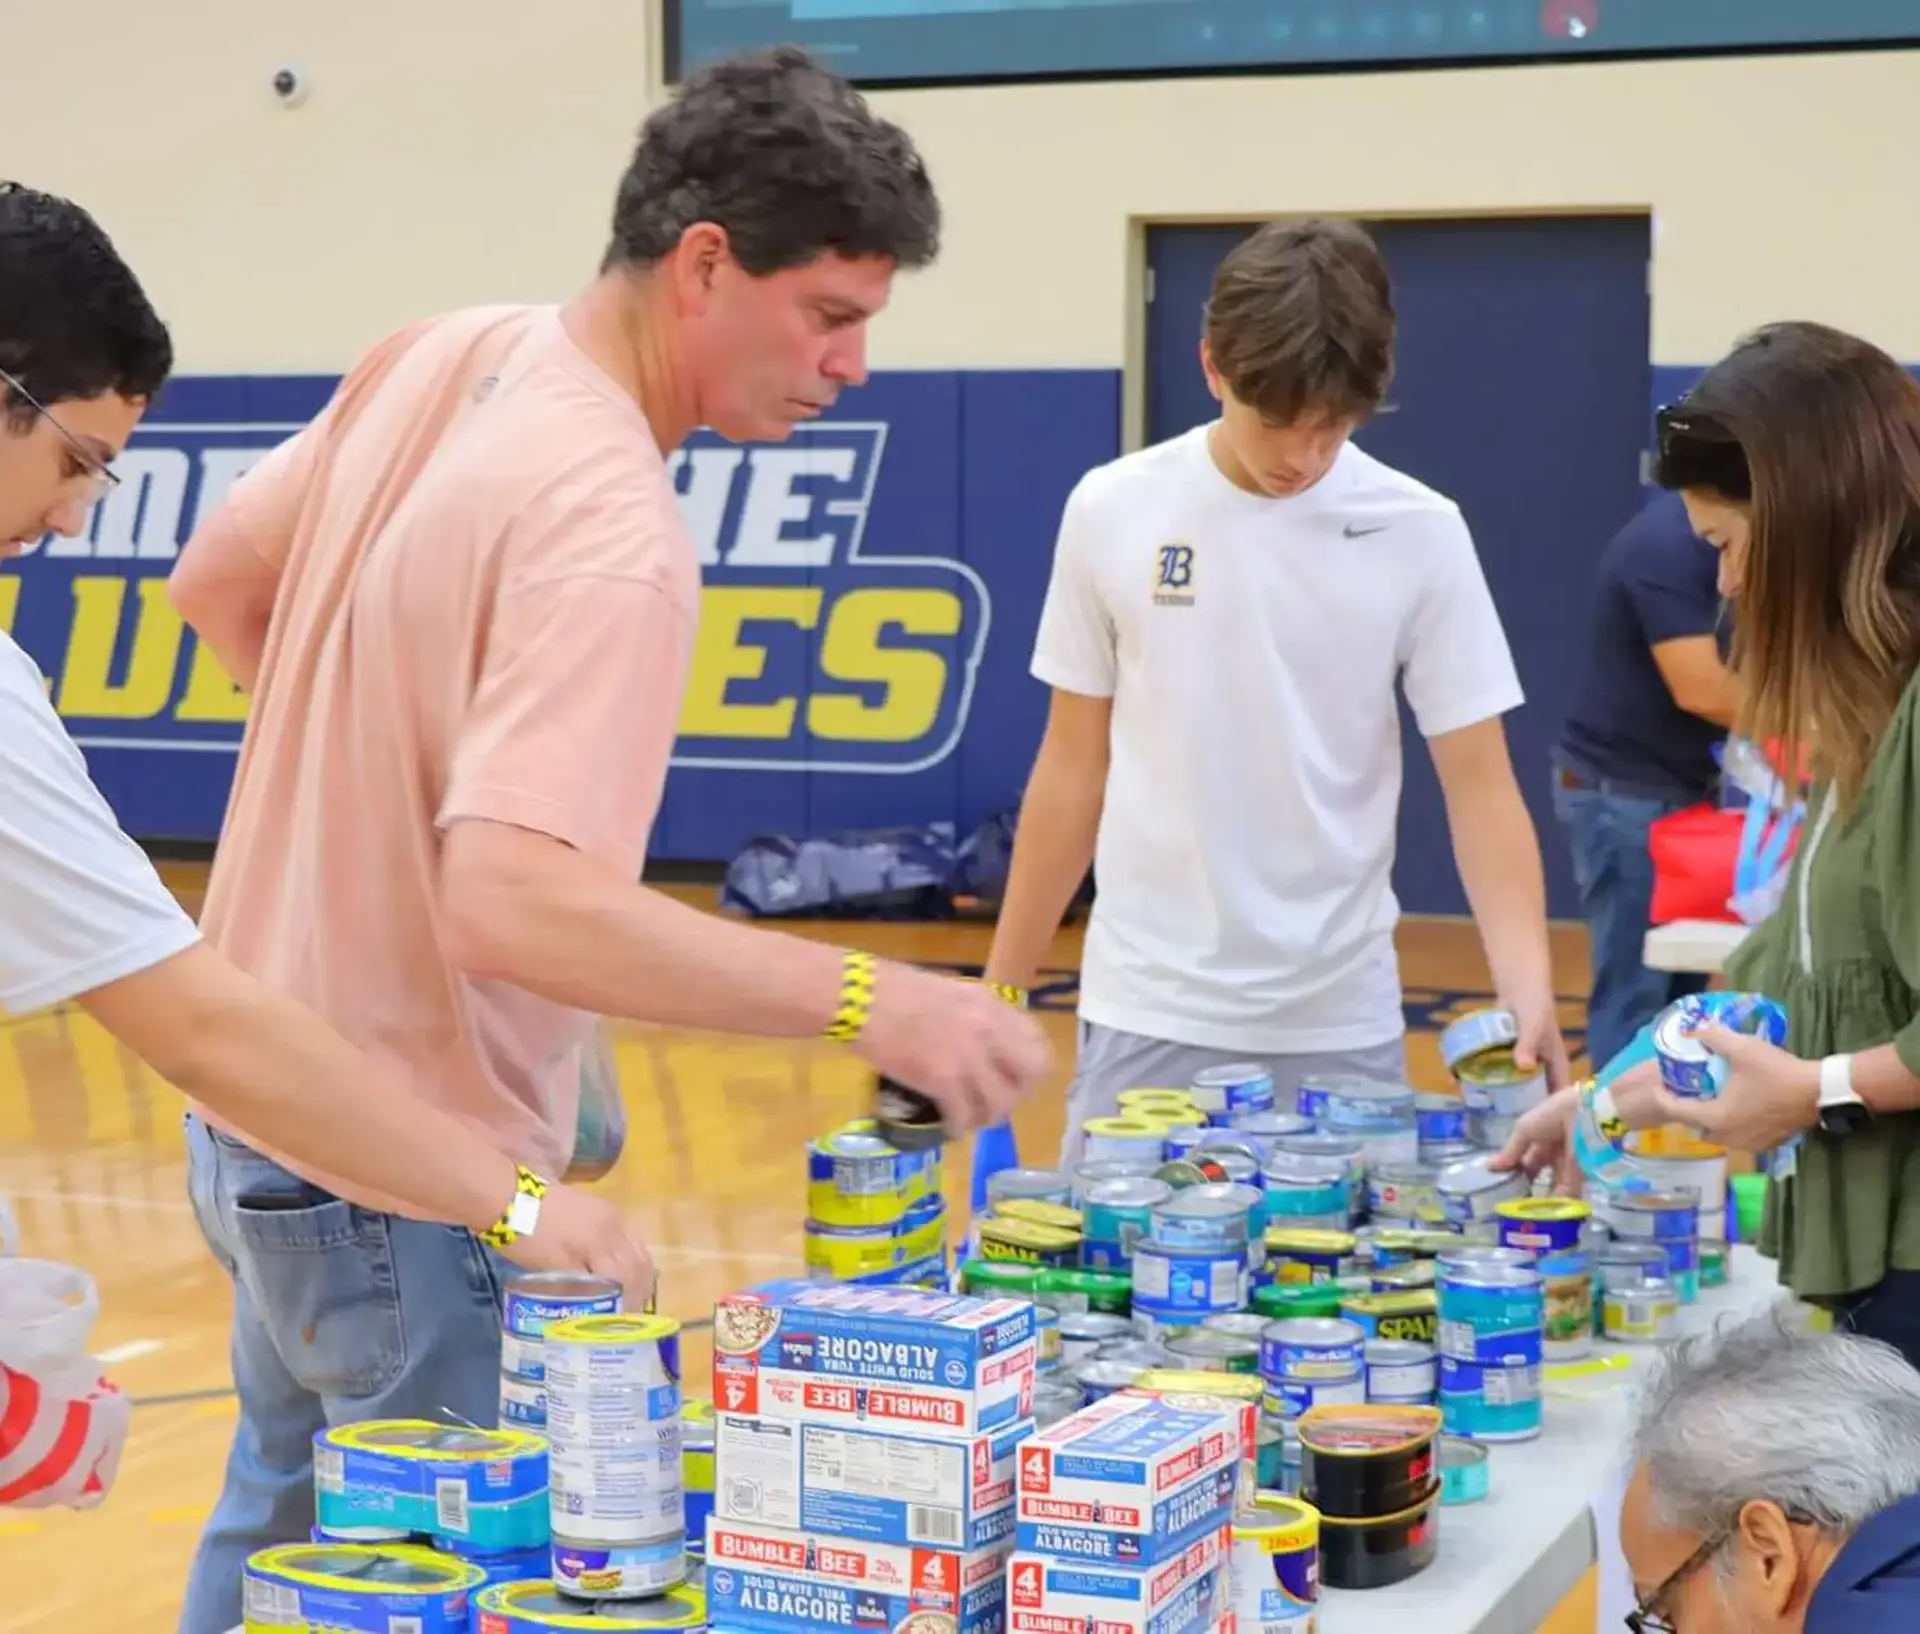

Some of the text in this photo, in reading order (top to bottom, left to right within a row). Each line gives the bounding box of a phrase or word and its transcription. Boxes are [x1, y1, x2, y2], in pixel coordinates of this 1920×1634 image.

[817, 1335, 938, 1366] ALBACORE
[726, 1388, 746, 1409] 4
[809, 1386, 957, 1420] BUMBLE BEE
[1025, 1453, 1046, 1476] 4
[1026, 1500, 1134, 1525] BUMBLE BEE
[722, 1535, 800, 1566] BUMBLE
[821, 1551, 858, 1575] BEE
[1035, 1534, 1113, 1557] ALBACORE
[923, 1555, 943, 1579] 4
[1016, 1567, 1038, 1590] 4
[743, 1575, 847, 1602] SOLID WHITE TUNA
[740, 1588, 853, 1625] ALBACORE
[1017, 1613, 1130, 1634] BUMBLE BEE
